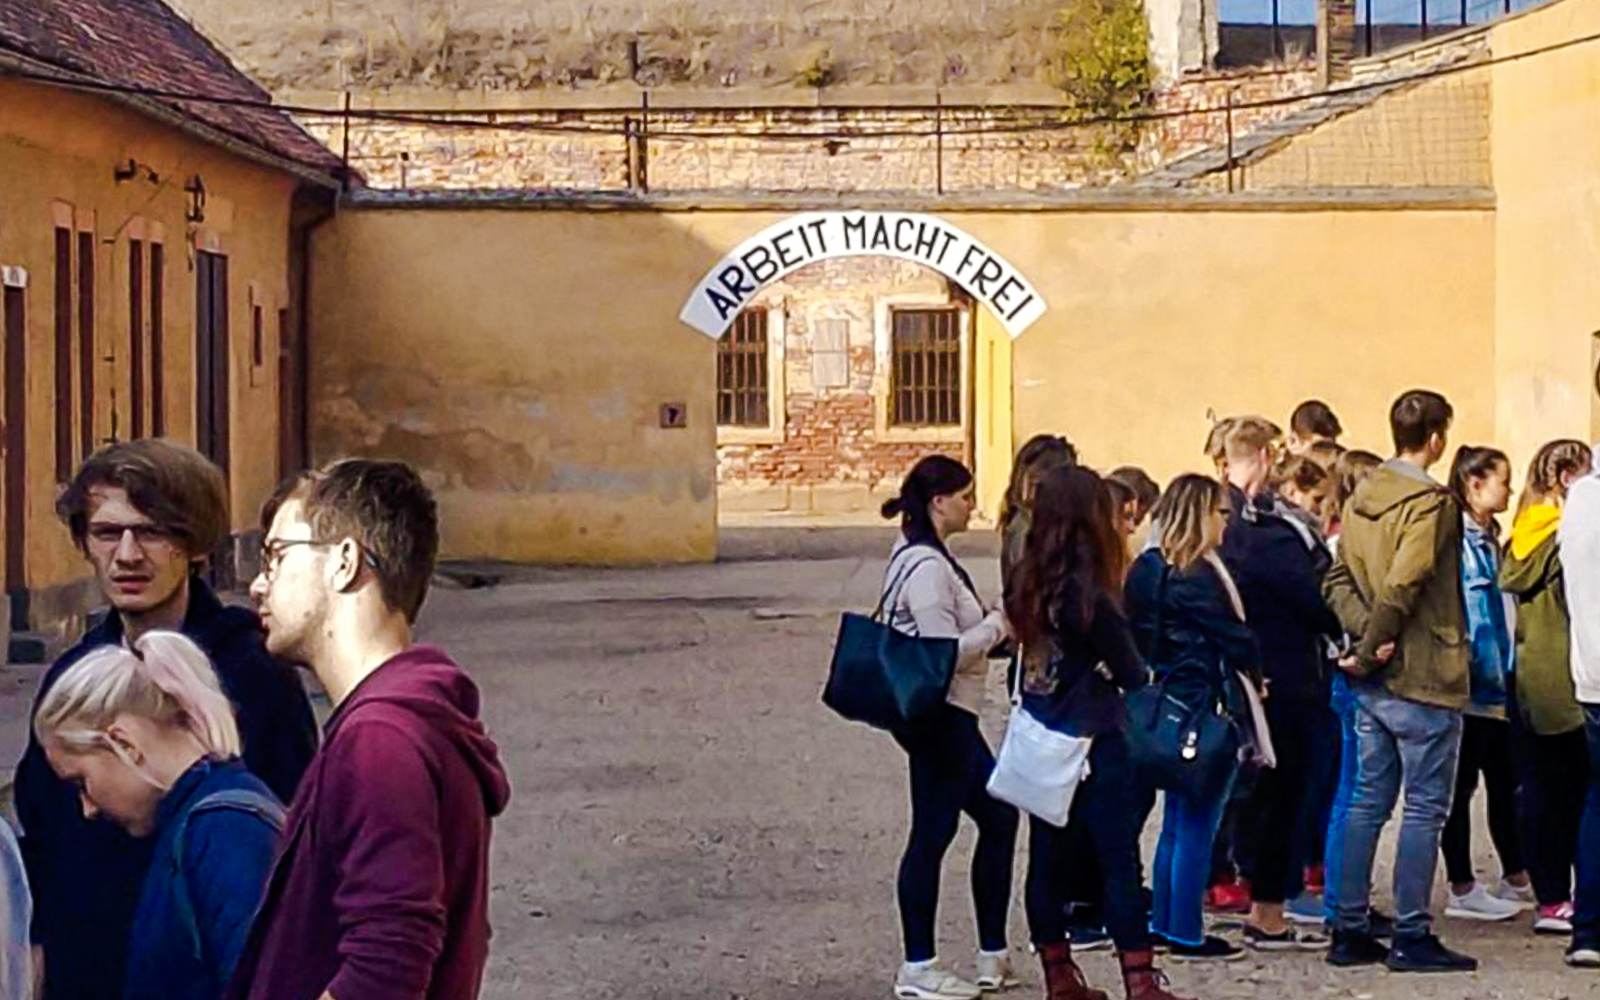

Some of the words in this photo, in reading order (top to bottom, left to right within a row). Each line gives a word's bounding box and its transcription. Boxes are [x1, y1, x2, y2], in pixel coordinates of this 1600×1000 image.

[705, 218, 828, 320] ARBEIT
[842, 215, 959, 264] MACHT
[954, 244, 1035, 322] FREI
